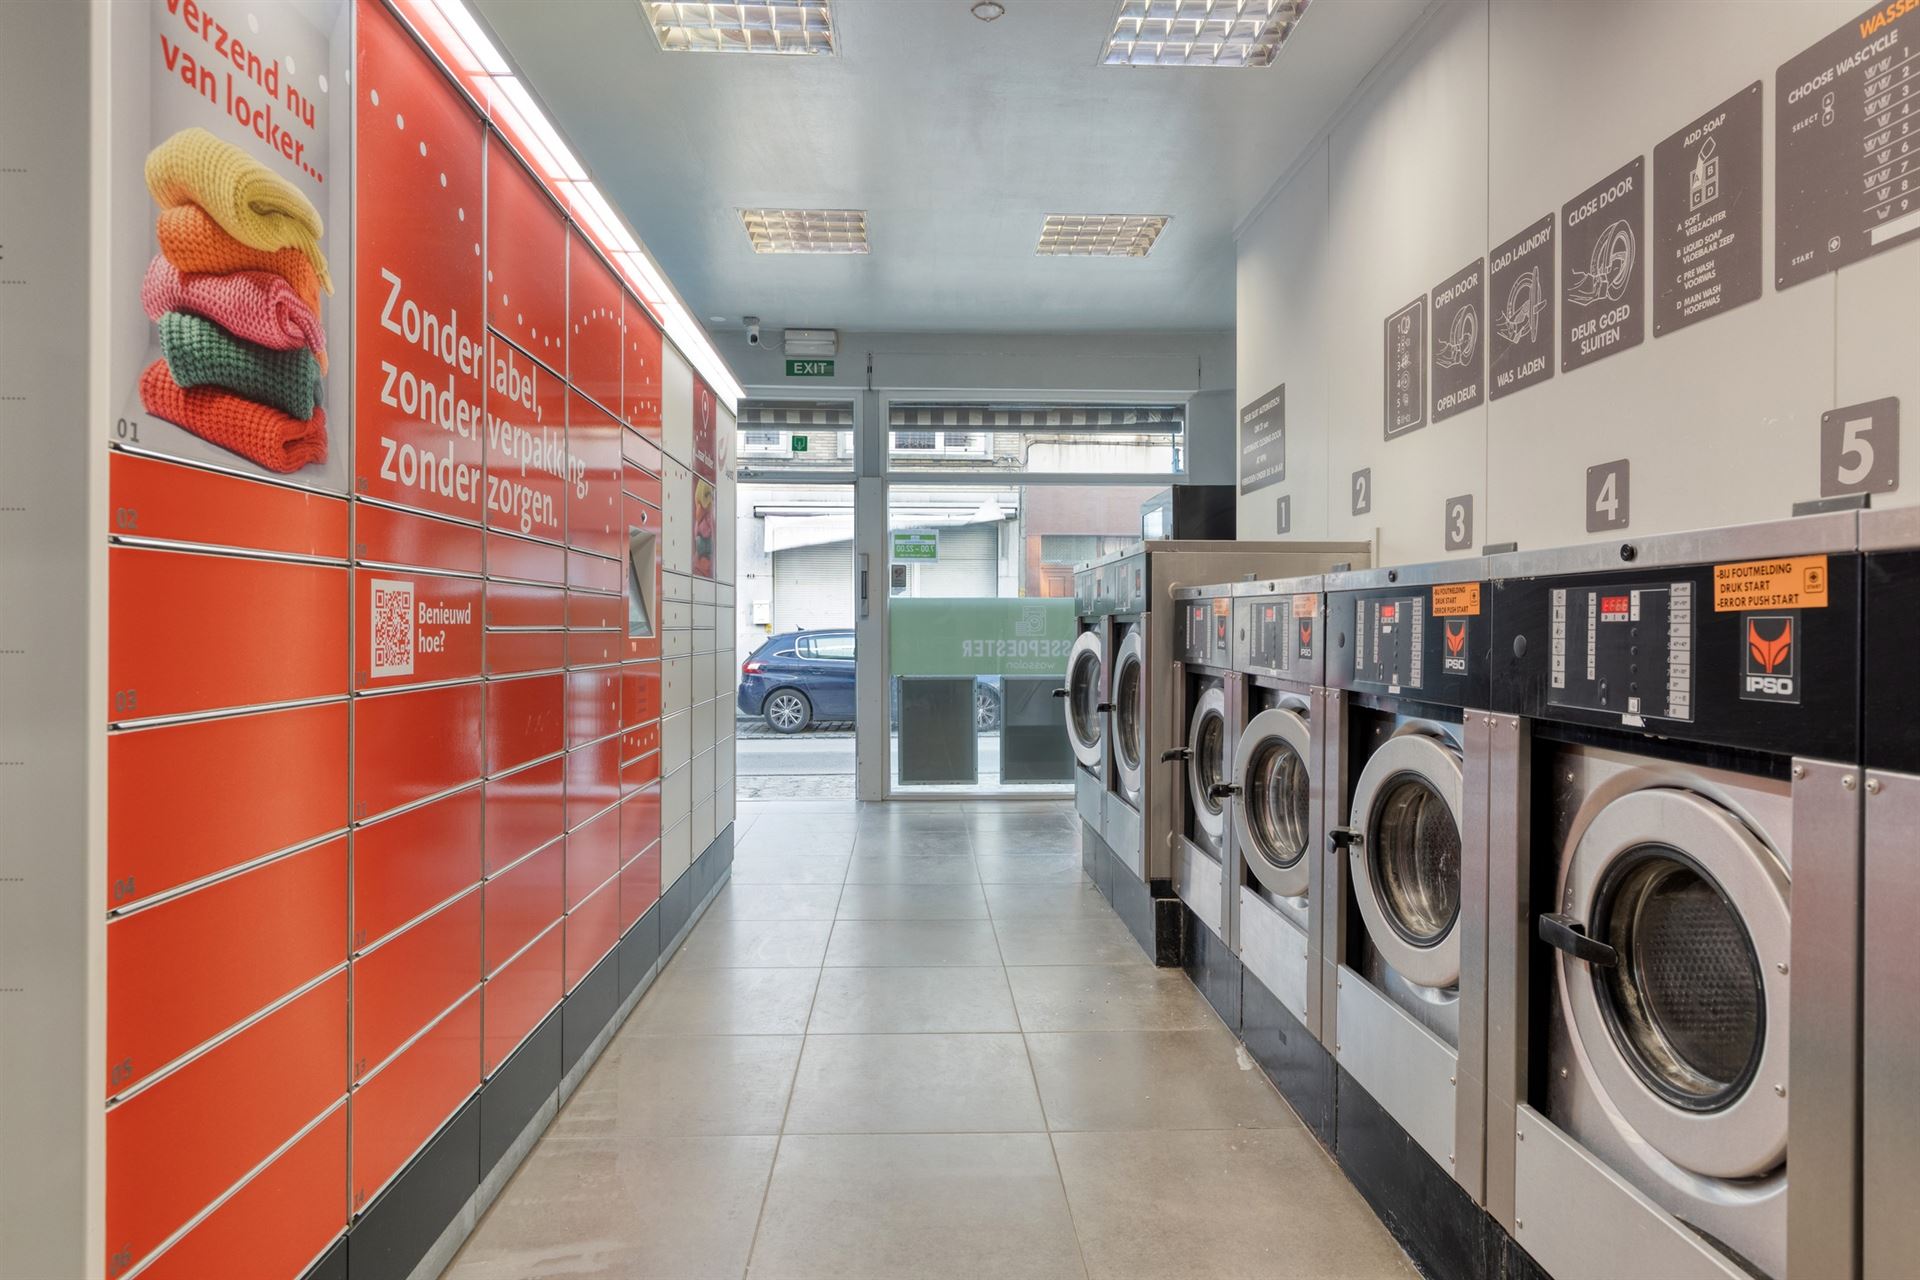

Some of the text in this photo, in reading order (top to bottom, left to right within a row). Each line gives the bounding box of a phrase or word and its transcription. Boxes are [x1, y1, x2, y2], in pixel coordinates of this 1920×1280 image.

[1903, 46, 1909, 58] 1
[1788, 28, 1898, 104] CHOOSE WASCYCLE
[1902, 65, 1909, 78] 2
[1902, 84, 1909, 97] 3
[160, 33, 323, 183] van locker...
[287, 83, 315, 130] nu
[1902, 103, 1909, 115] 4
[1683, 113, 1726, 148] ADD SOAP
[1792, 112, 1818, 133] SELECT
[1902, 121, 1909, 134] 5
[1901, 141, 1908, 153] 6
[1707, 165, 1714, 177] B
[1901, 160, 1909, 173] 7
[1694, 185, 1714, 204] C D
[1901, 179, 1908, 191] 8
[1568, 176, 1633, 227] CLOSE DOOR
[1901, 199, 1908, 210] 9
[1677, 213, 1701, 233] A SOFT
[1685, 210, 1727, 237] VERZACHTER
[1491, 226, 1552, 275] LOAD LAUNDRY
[1676, 228, 1723, 258] B LIQUID SOAP
[1719, 233, 1735, 248] ZEEP
[1792, 251, 1814, 266] START
[1676, 260, 1715, 283] C PRE WASH
[1684, 269, 1717, 290] VOORWAS
[1435, 273, 1479, 310] OPEN DOOR
[1676, 284, 1722, 310] D MAIN WASH
[1684, 295, 1721, 316] HOOFDWAS
[1571, 304, 1630, 343] DEUR GOED
[380, 266, 542, 423] Zonder label,
[1581, 326, 1620, 355] SLUITEN
[793, 363, 827, 374] EXIT
[1497, 356, 1545, 387] WAS LADEN
[1437, 384, 1477, 412] OPEN DEUR
[118, 417, 140, 443] 01
[380, 360, 589, 499] zonder verpakking,
[1837, 416, 1874, 485] 5
[380, 436, 558, 535] zonder zorgen.
[1356, 476, 1366, 509] 2
[1595, 472, 1618, 521] 4
[116, 507, 138, 529] 02
[1280, 502, 1286, 528] 1
[1451, 504, 1465, 543] 3
[1731, 563, 1792, 578] FOUTMELDING
[1720, 580, 1770, 594] DRUK START
[1748, 595, 1770, 606] PUSH
[1772, 593, 1799, 604] START
[418, 602, 471, 625] Benieuwd
[418, 628, 446, 653] hoe?
[1445, 659, 1465, 670] IPSO
[1746, 676, 1793, 695] IPSO
[115, 689, 138, 713] 03
[114, 875, 136, 900] 04
[111, 1057, 133, 1087] 05
